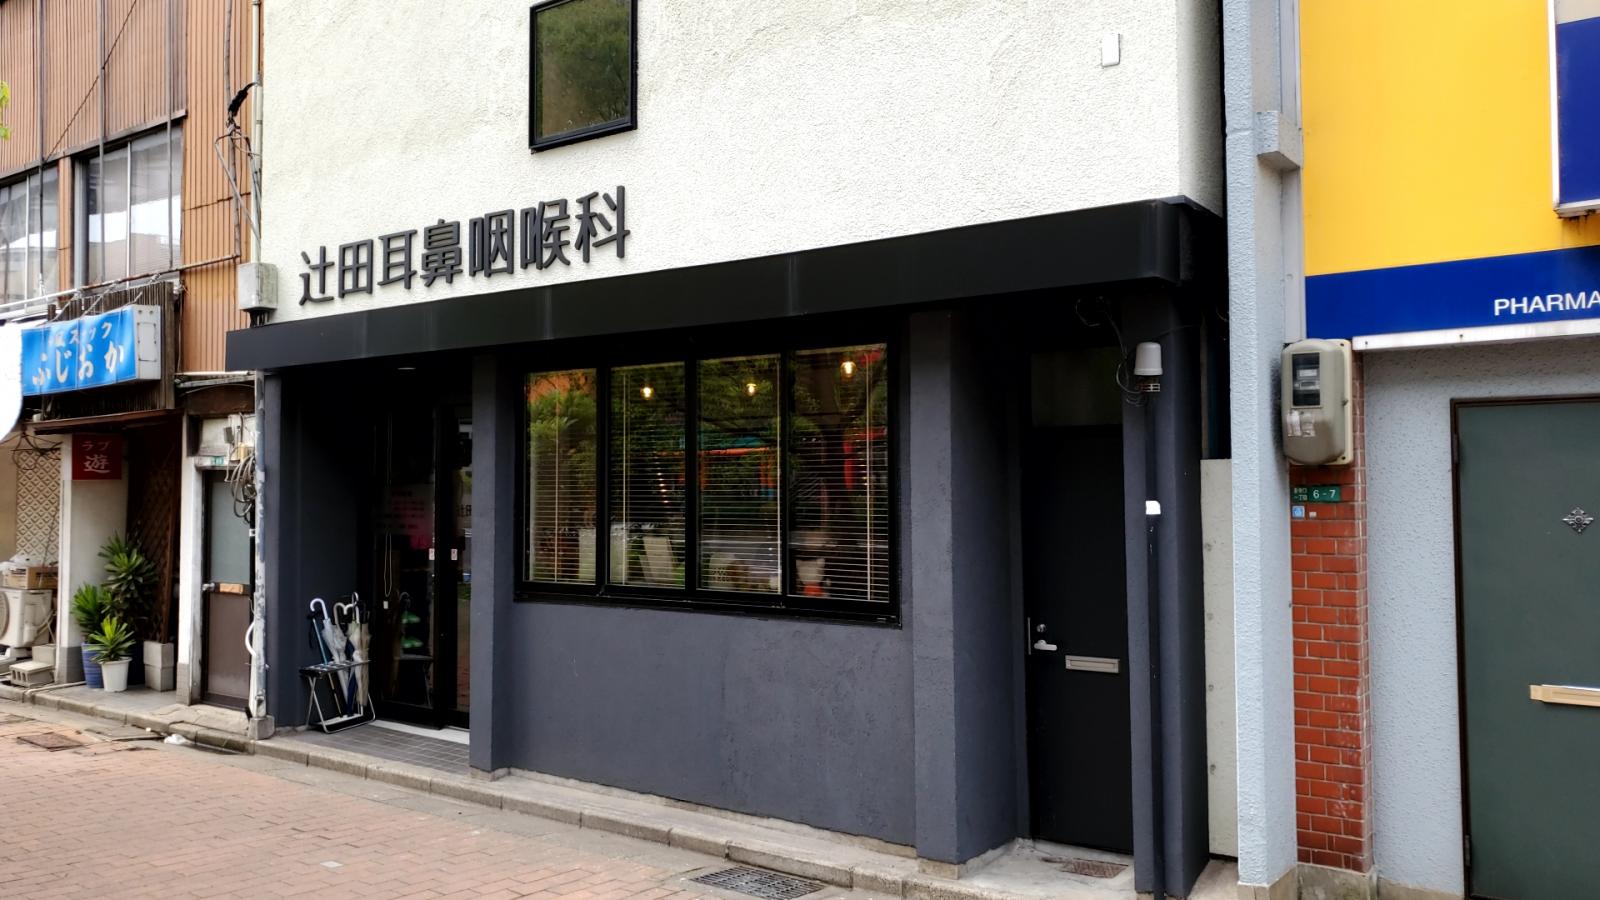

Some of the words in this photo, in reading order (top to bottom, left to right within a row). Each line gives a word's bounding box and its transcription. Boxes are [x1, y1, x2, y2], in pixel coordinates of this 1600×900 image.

[299, 185, 631, 306] 辻田耳鼻咽喉科
[1494, 290, 1600, 316] PHARMA
[32, 341, 125, 386] ふじおか
[83, 454, 111, 474] 遊
